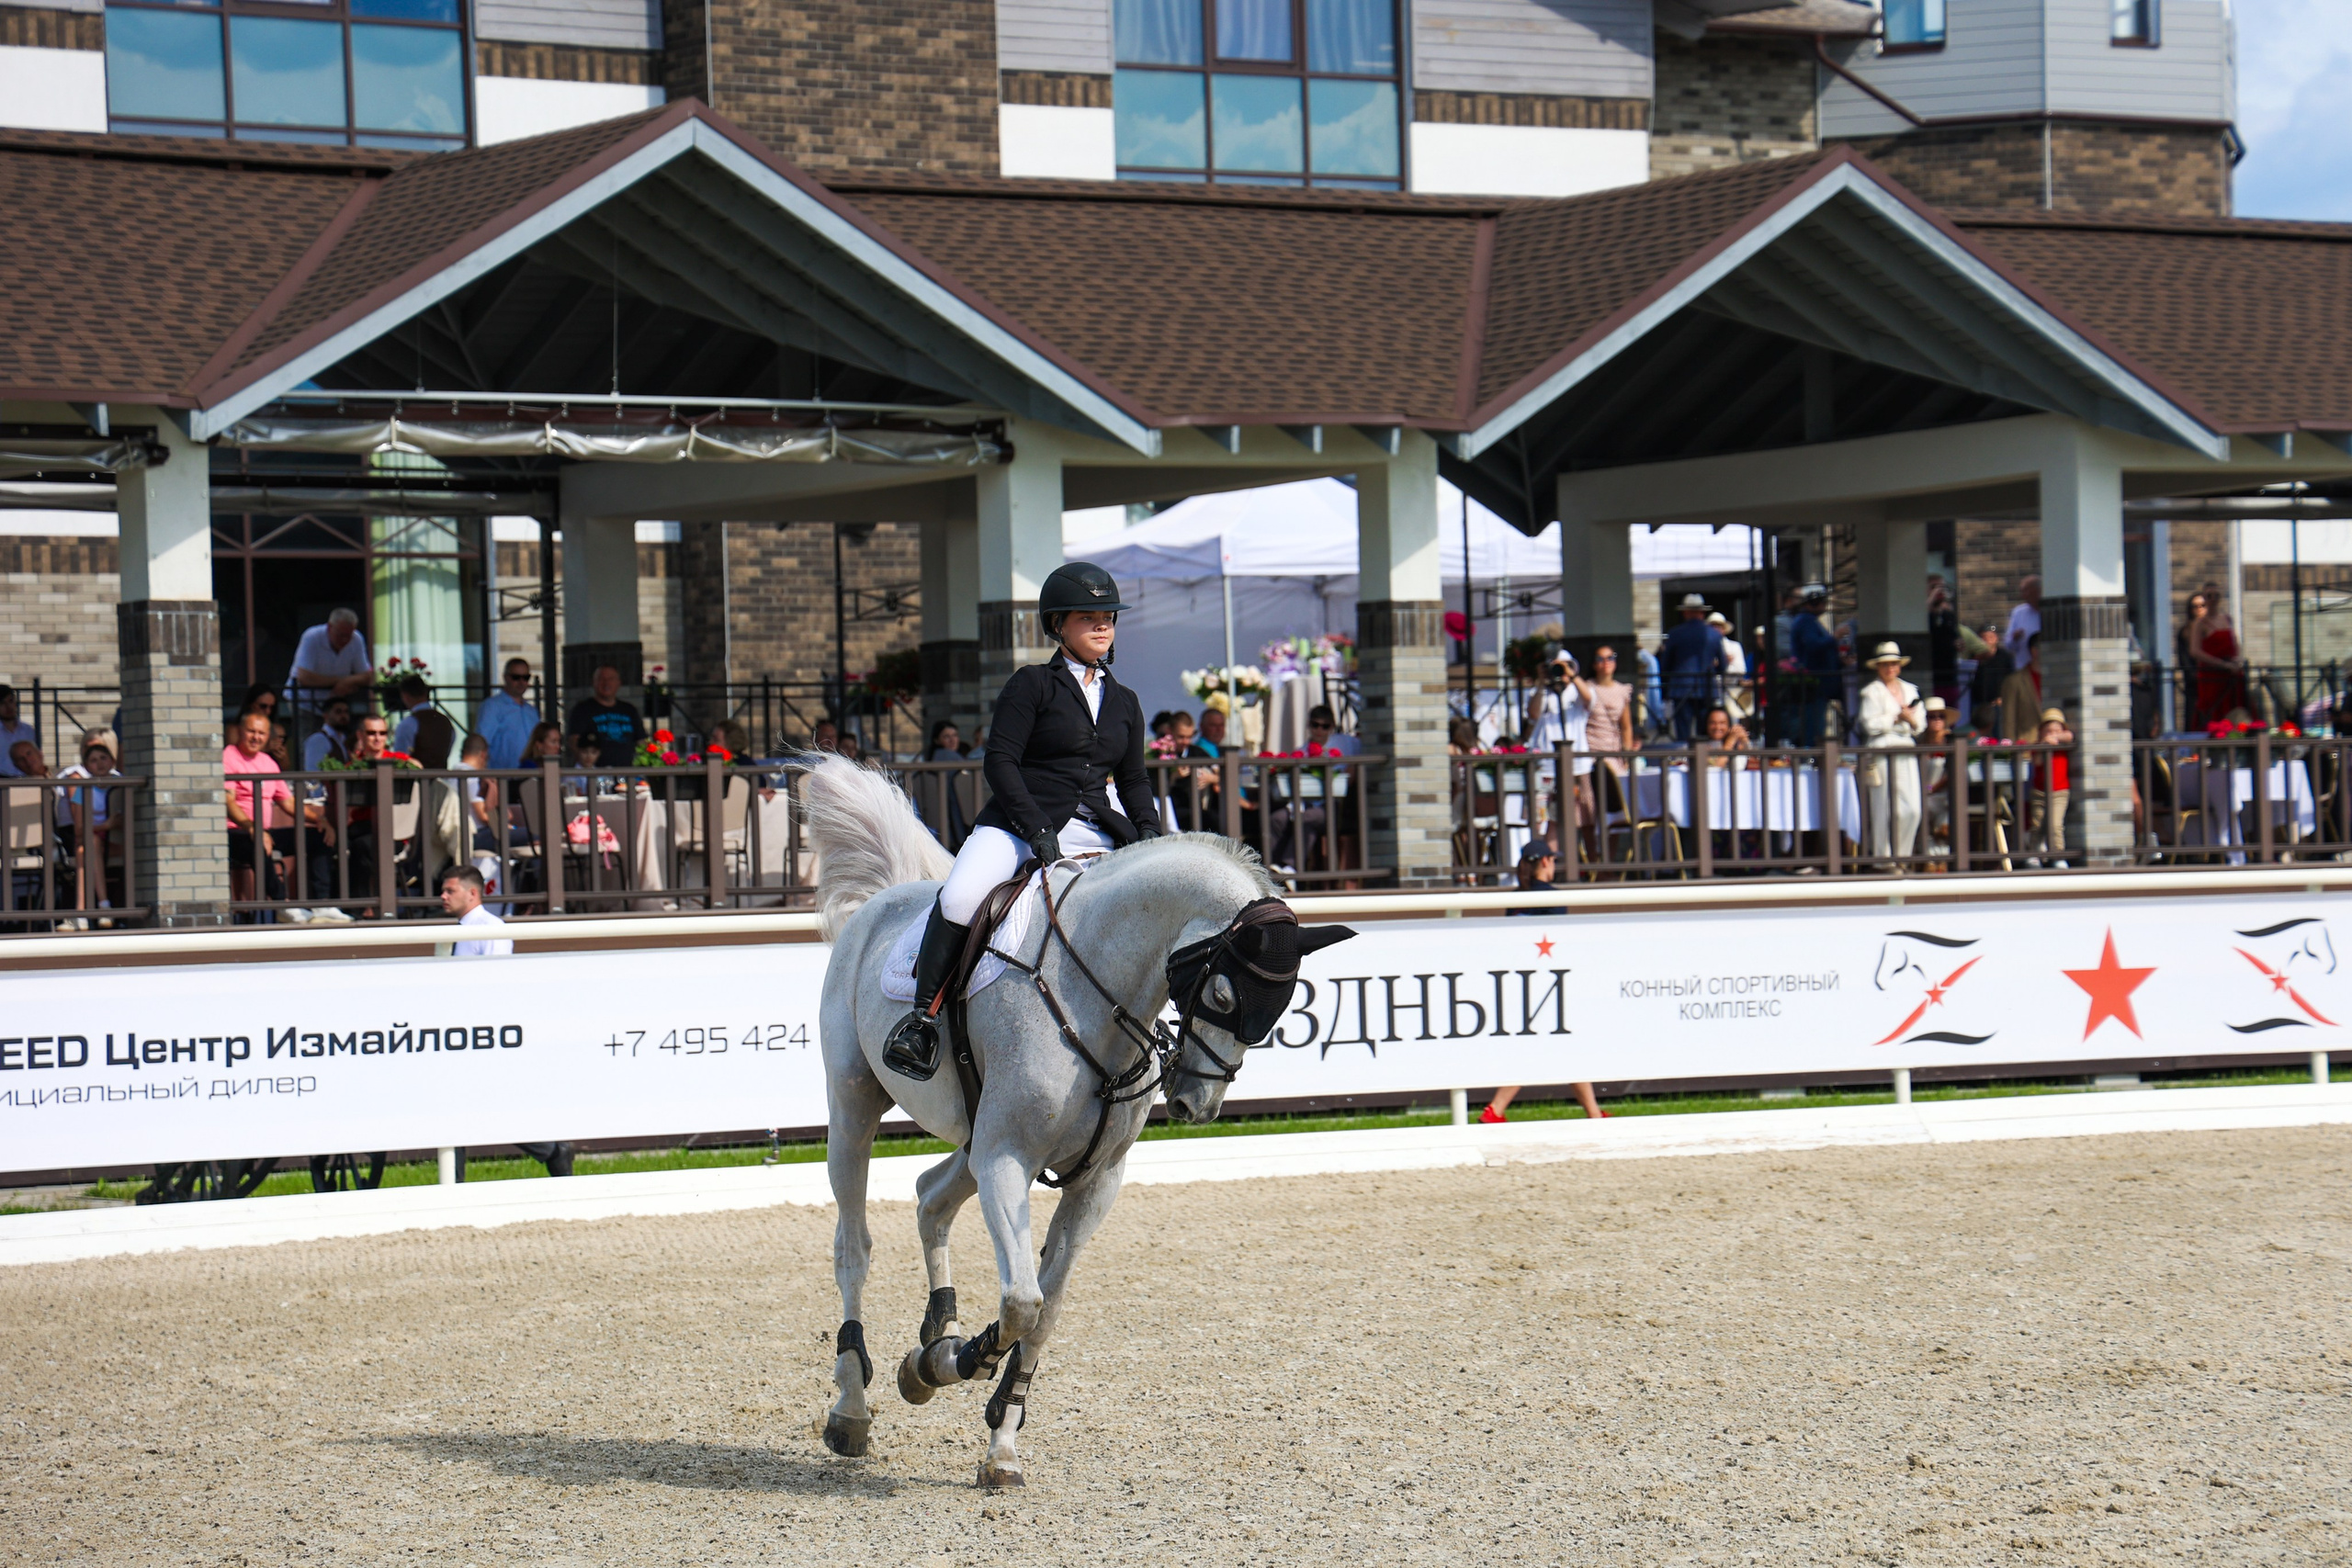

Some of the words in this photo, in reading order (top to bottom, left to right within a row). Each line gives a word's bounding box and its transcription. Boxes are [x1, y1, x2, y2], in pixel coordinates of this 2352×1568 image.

[1244, 934, 1572, 1061] ЗДНЫЙ
[1620, 976, 1702, 998] КОННЫЙ
[1708, 971, 1840, 995] СПОРТИВНЫЙ
[1679, 999, 1782, 1021] КОМПЛЕКС
[0, 1034, 88, 1070] EED
[106, 1032, 251, 1070] Центр
[267, 1021, 524, 1058] Измайлово
[604, 1031, 646, 1056] +7
[659, 1027, 729, 1055] 495
[741, 1022, 810, 1052] 424
[208, 1076, 317, 1100] дилер
